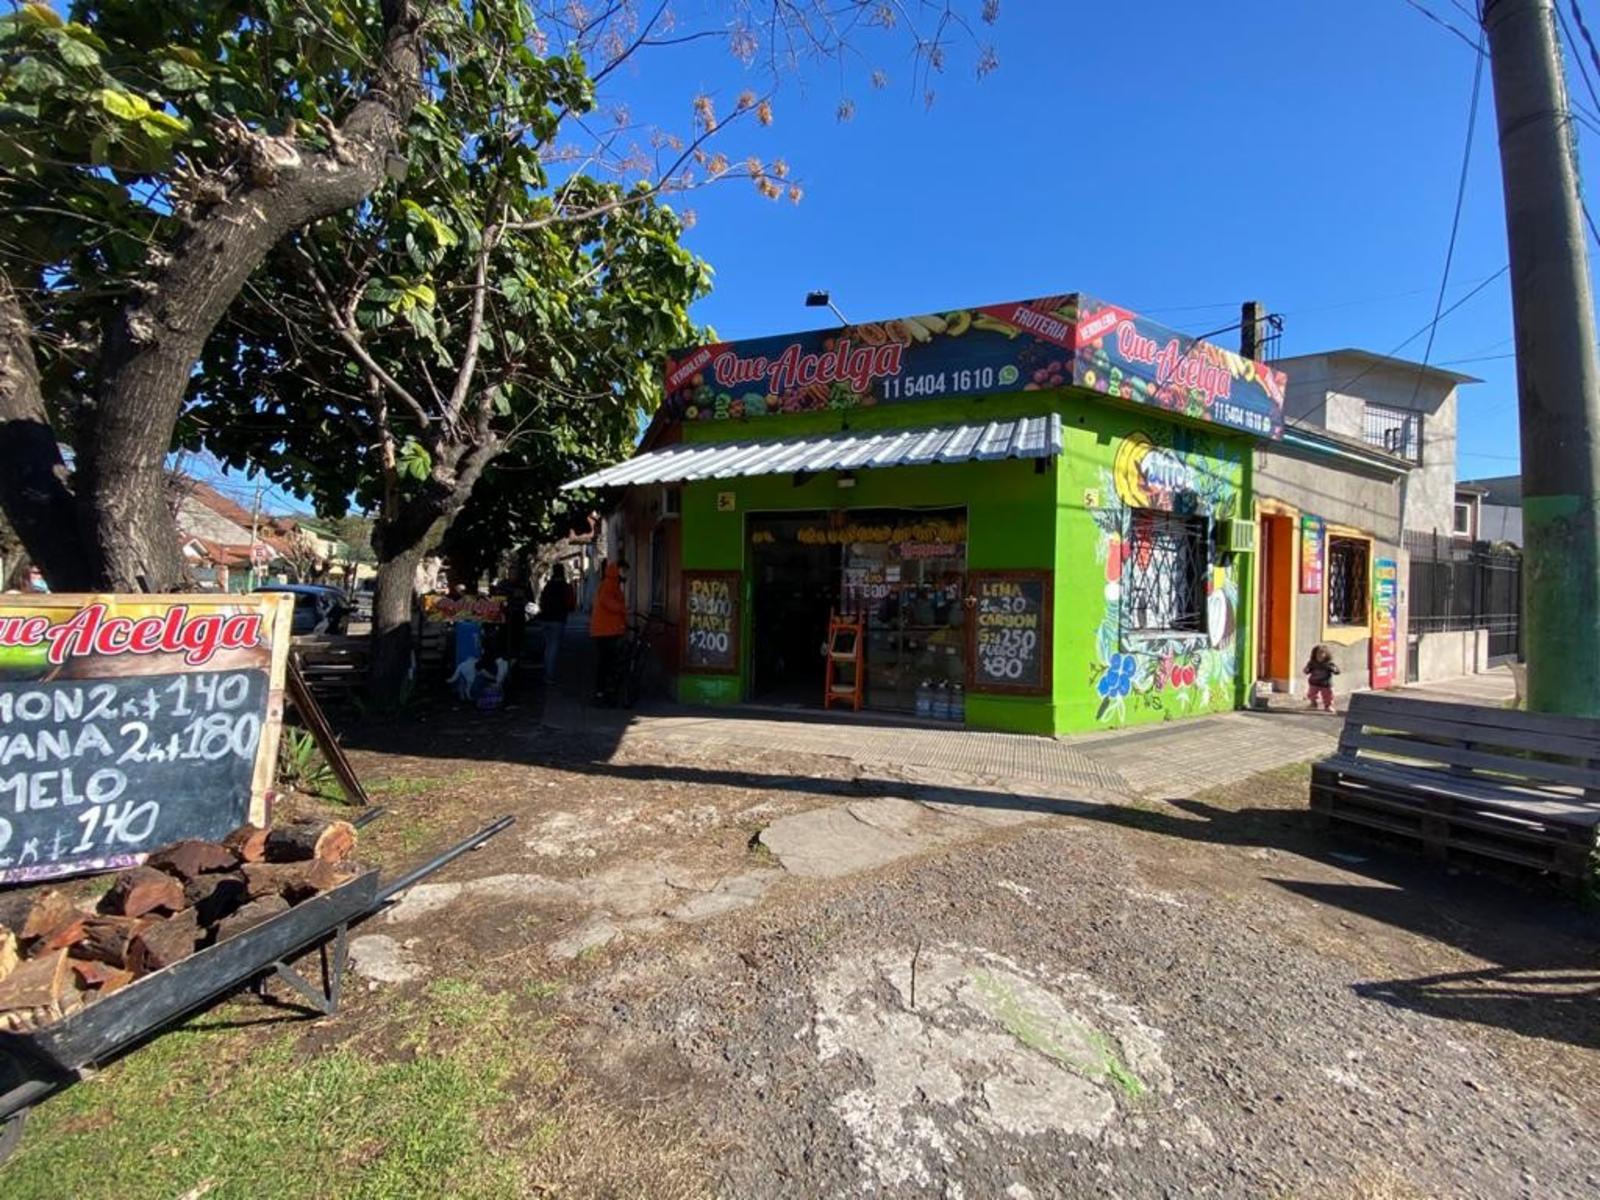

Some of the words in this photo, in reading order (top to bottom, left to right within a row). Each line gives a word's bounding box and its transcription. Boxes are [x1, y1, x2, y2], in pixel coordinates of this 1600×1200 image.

[1011, 307, 1069, 341] FRUTERIA
[714, 351, 770, 387] Que
[768, 338, 905, 394] Acelga
[1116, 320, 1157, 363] Que
[1154, 338, 1232, 407] Acelga
[882, 379, 901, 399] 11
[904, 372, 946, 397] 5404
[951, 367, 994, 392] 1610
[692, 580, 729, 600] PAPA
[46, 602, 260, 666] Acelga
[690, 630, 728, 652] $200
[983, 656, 1022, 678] $80
